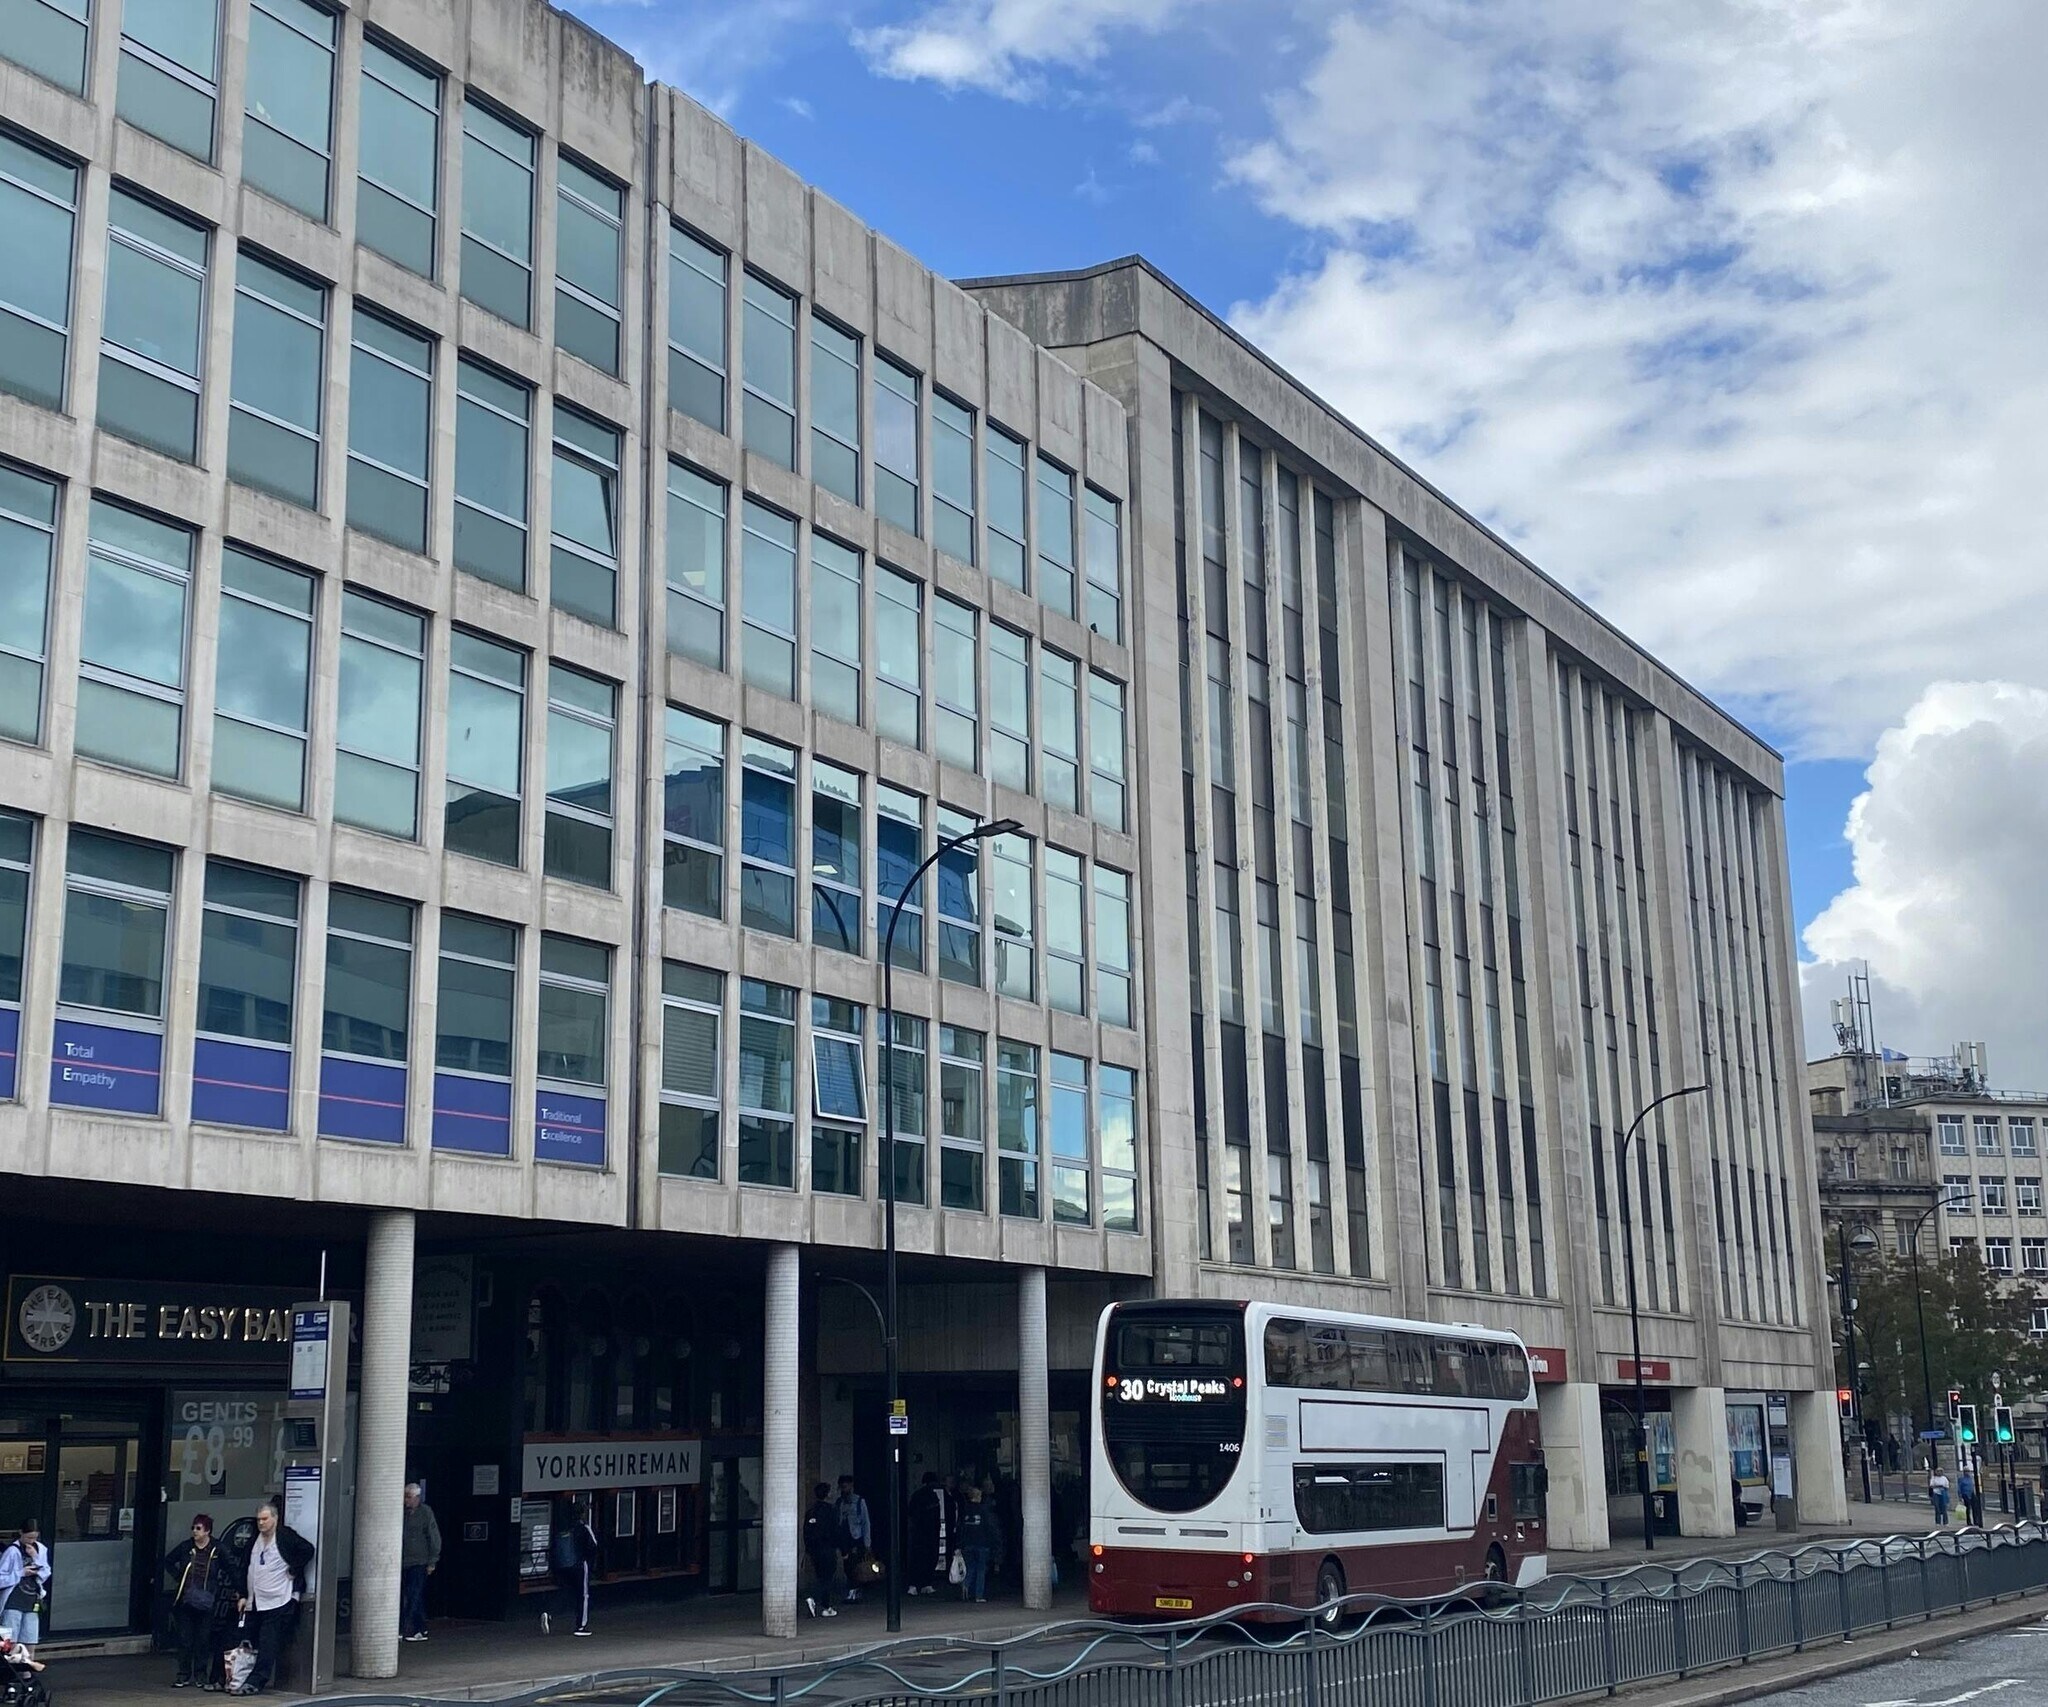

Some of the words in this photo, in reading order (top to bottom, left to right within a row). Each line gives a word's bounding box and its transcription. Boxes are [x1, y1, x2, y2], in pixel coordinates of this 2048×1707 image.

[64, 1043, 94, 1059] Total
[63, 1067, 116, 1089] Empathy
[541, 1108, 582, 1124] Traditional
[541, 1129, 582, 1144] Excellence
[26, 1293, 44, 1316] THE
[47, 1289, 73, 1316] EASY
[85, 1302, 147, 1338] THE
[159, 1304, 240, 1339] EASY
[26, 1323, 71, 1348] BARBER
[1120, 1379, 1144, 1401] 30
[1146, 1379, 1188, 1397] Crystal
[1190, 1380, 1226, 1395] Peaks
[182, 1401, 258, 1422] GENTS
[1219, 1443, 1240, 1453] 1406
[536, 1451, 690, 1479] YORKSHIREMAN
